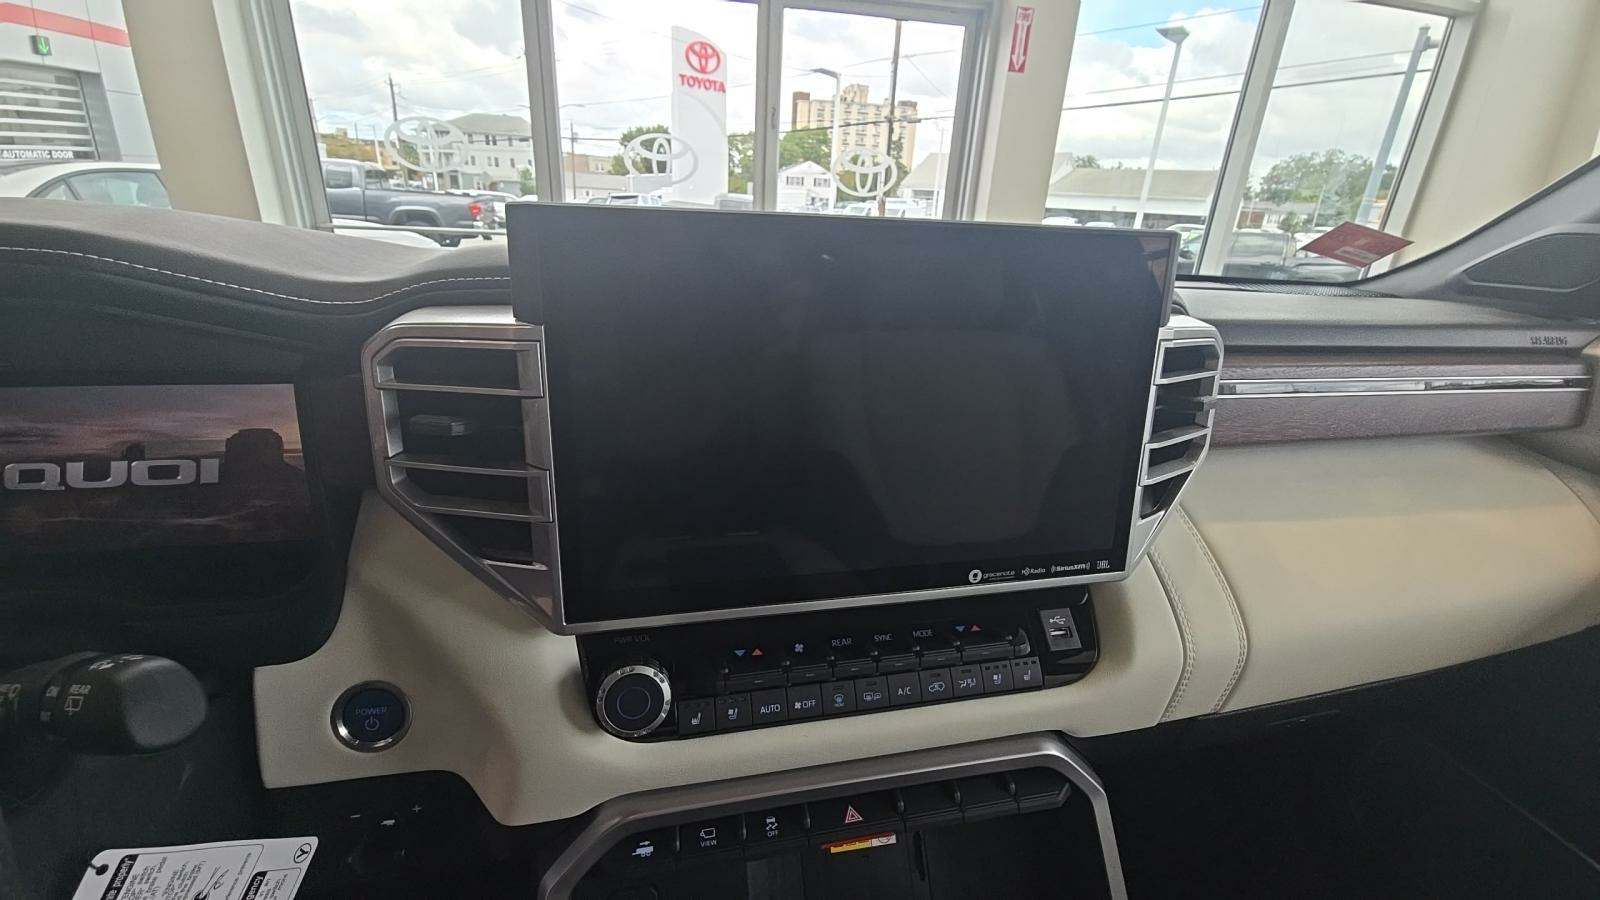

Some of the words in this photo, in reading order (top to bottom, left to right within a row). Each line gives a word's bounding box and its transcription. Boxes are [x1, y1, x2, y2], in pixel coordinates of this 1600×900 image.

[678, 73, 727, 93] TOYOTA
[2, 149, 51, 158] AUTOMATIC
[51, 150, 74, 158] DOOR
[4, 458, 220, 491] QUOI
[873, 633, 893, 643] SYNC
[912, 629, 933, 639] MODE
[831, 637, 852, 647] REAR
[897, 686, 912, 696] A/C
[759, 703, 781, 714] AUTO
[802, 699, 816, 708] OFF
[767, 829, 779, 838] OFF
[700, 838, 717, 848] VIEW
